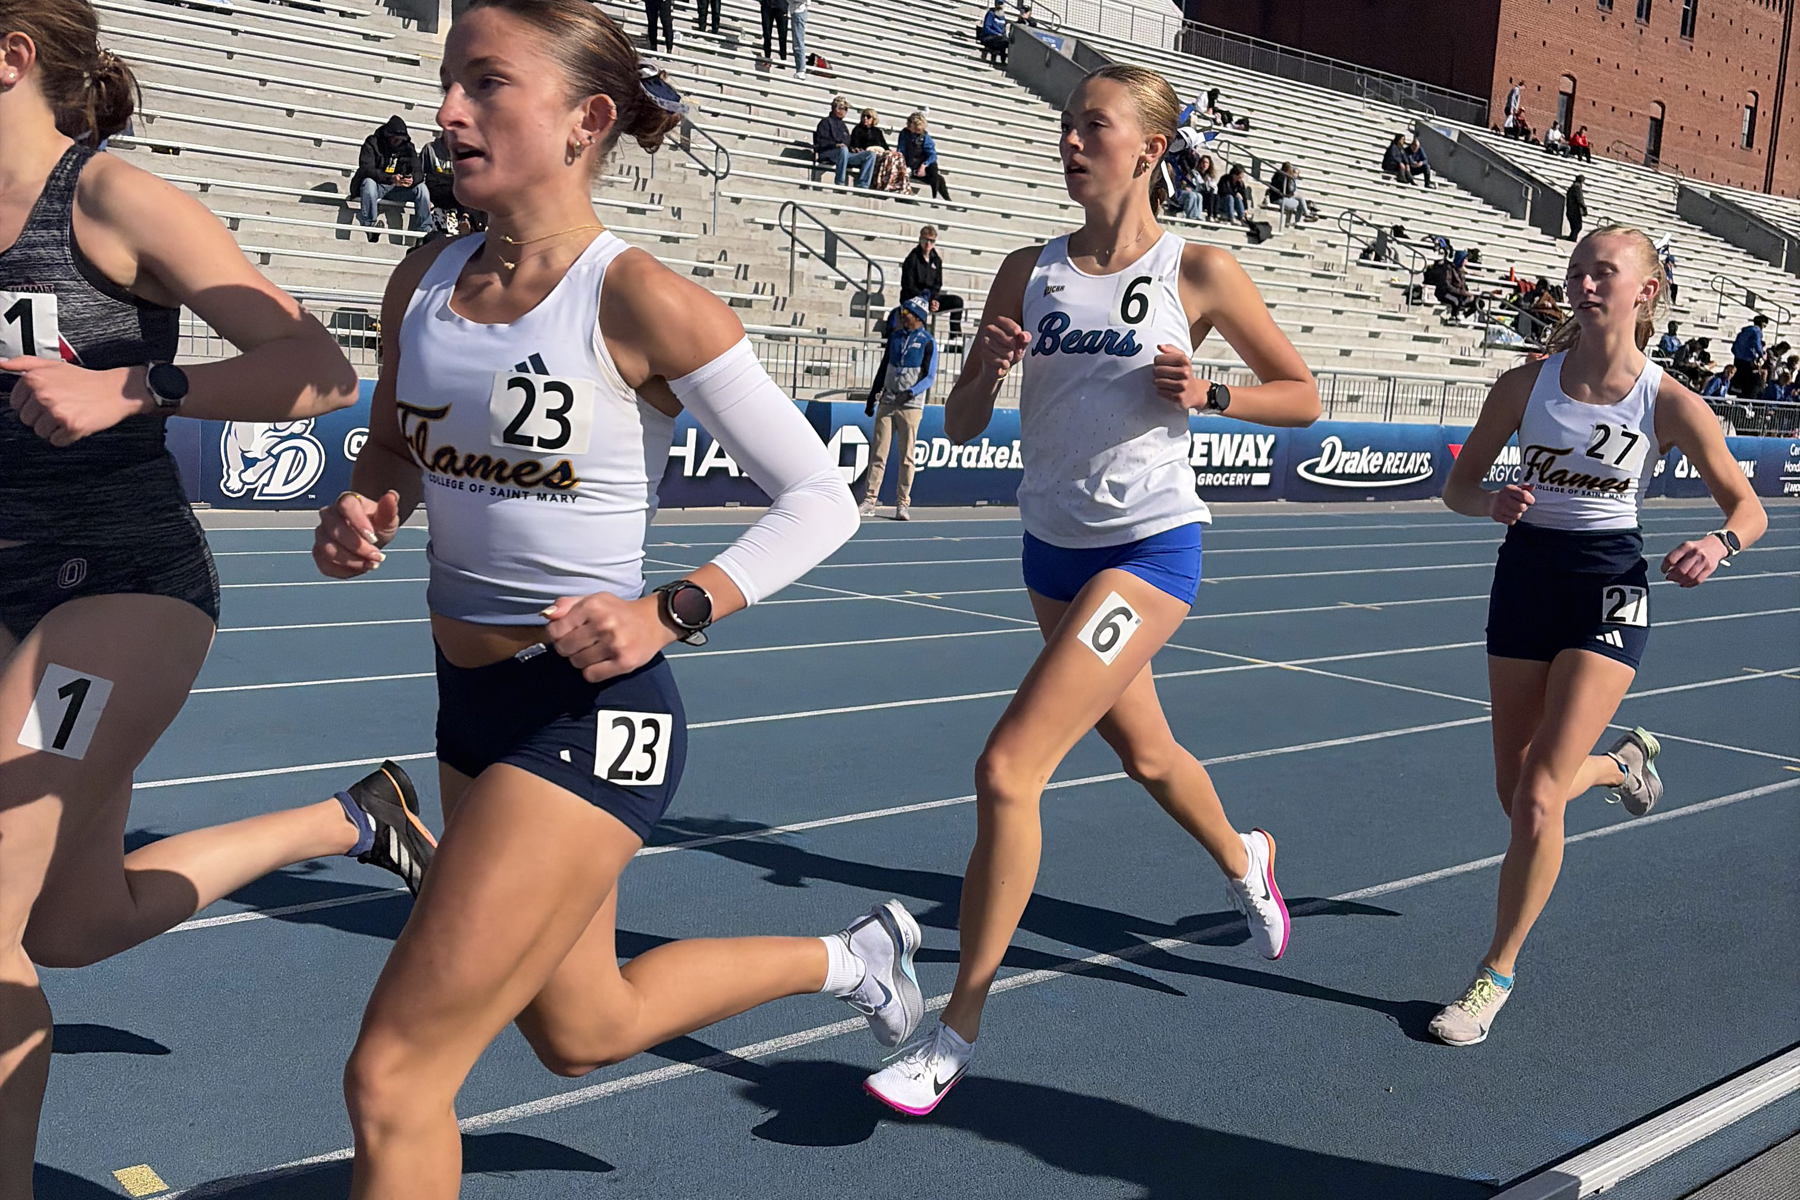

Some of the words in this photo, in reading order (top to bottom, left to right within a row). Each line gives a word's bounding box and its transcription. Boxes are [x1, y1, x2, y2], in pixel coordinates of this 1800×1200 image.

[1120, 276, 1152, 325] 6
[4, 298, 37, 356] 1
[1031, 311, 1143, 357] Bears
[503, 376, 574, 450] 23
[1189, 433, 1275, 467] EWAY
[1315, 436, 1384, 474] Drake
[1382, 452, 1431, 474] RELAYS
[1523, 444, 1632, 492] Flames
[1585, 424, 1640, 466] 27
[429, 474, 464, 492] COLLEGE
[469, 483, 486, 494] OF
[490, 488, 531, 501] SAINT
[536, 492, 579, 504] MARY
[1197, 472, 1251, 486] GROCERY
[1581, 490, 1605, 498] SAINT
[1605, 588, 1642, 622] 27
[1092, 606, 1133, 653] 6
[52, 677, 92, 750] 1
[607, 716, 661, 782] 23
